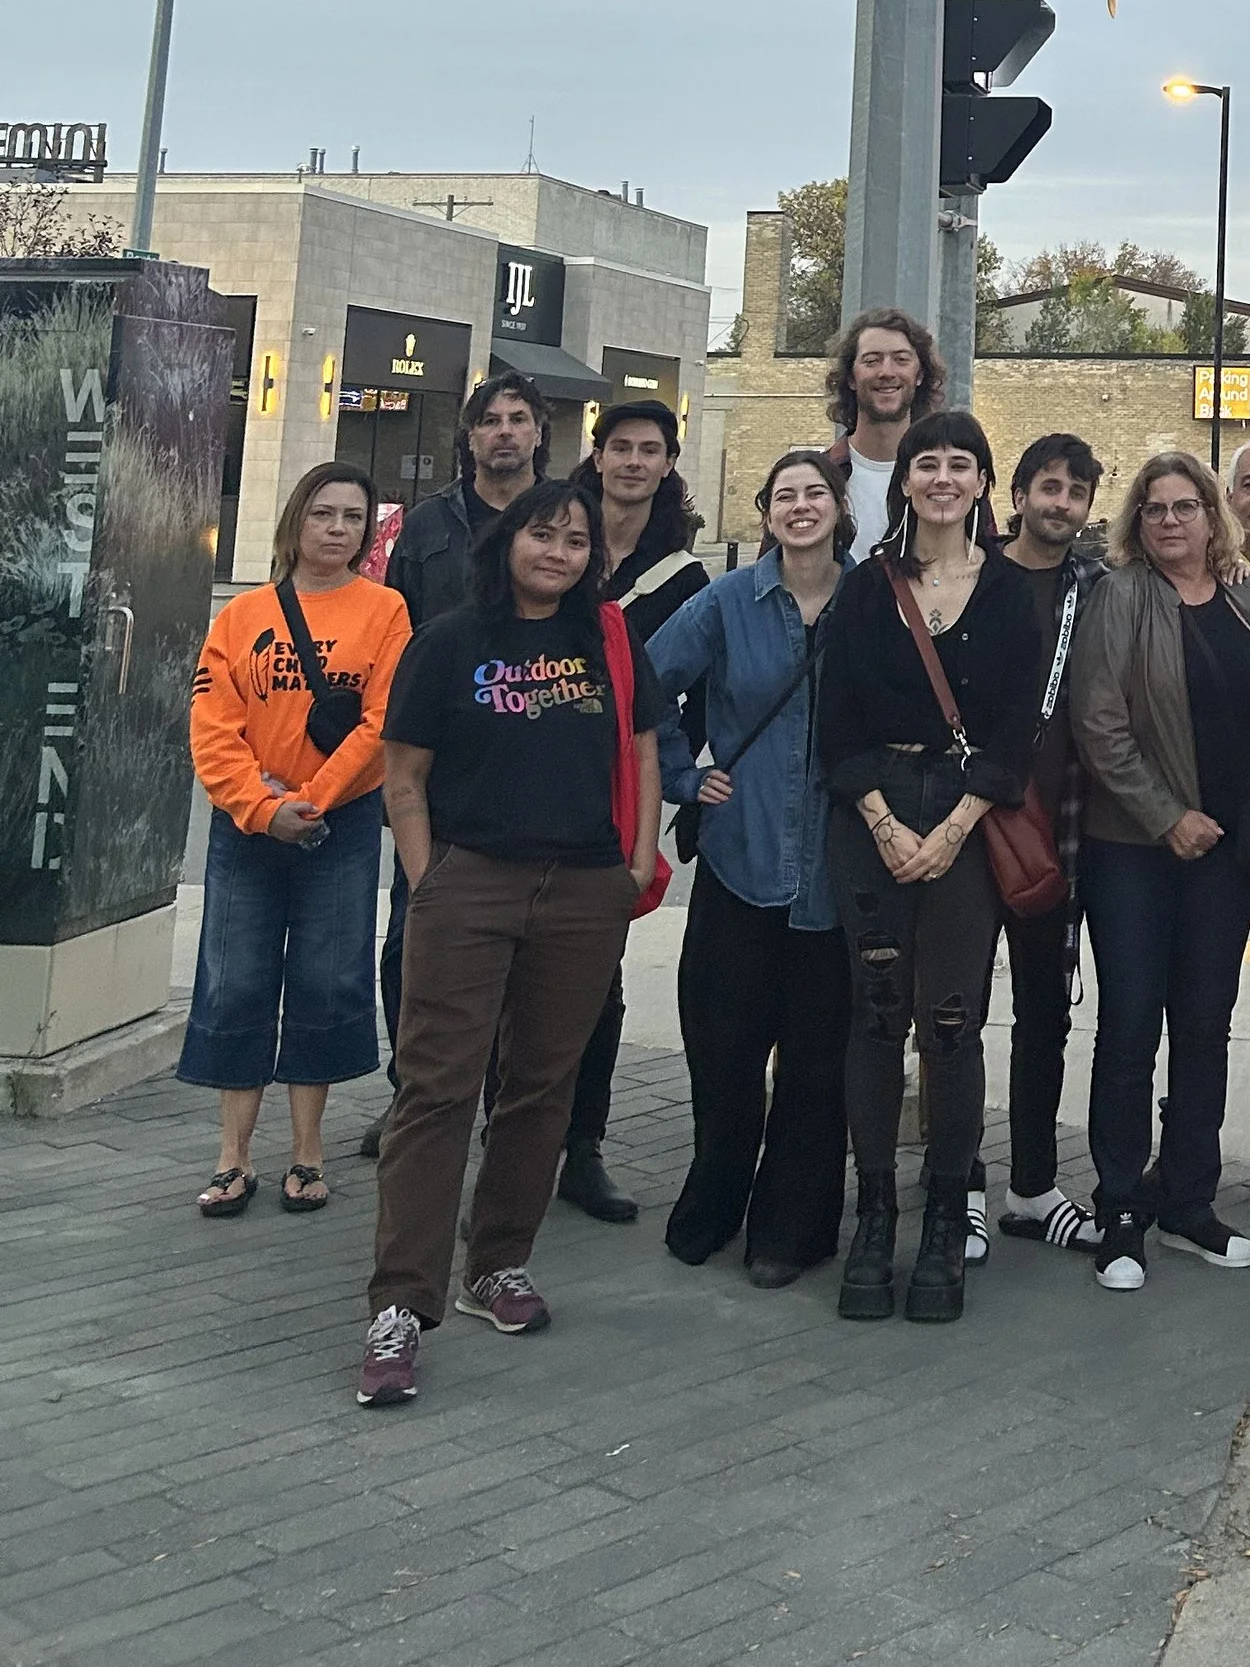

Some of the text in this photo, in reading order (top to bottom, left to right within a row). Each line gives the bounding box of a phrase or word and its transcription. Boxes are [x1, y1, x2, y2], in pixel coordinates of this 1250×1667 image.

[506, 261, 535, 315] IJL
[391, 358, 424, 376] ROLEX
[274, 639, 337, 655] EVRY
[273, 655, 328, 673] CHD
[474, 654, 587, 685] Outdoor
[271, 671, 362, 692] MAERS
[474, 678, 606, 720] Together
